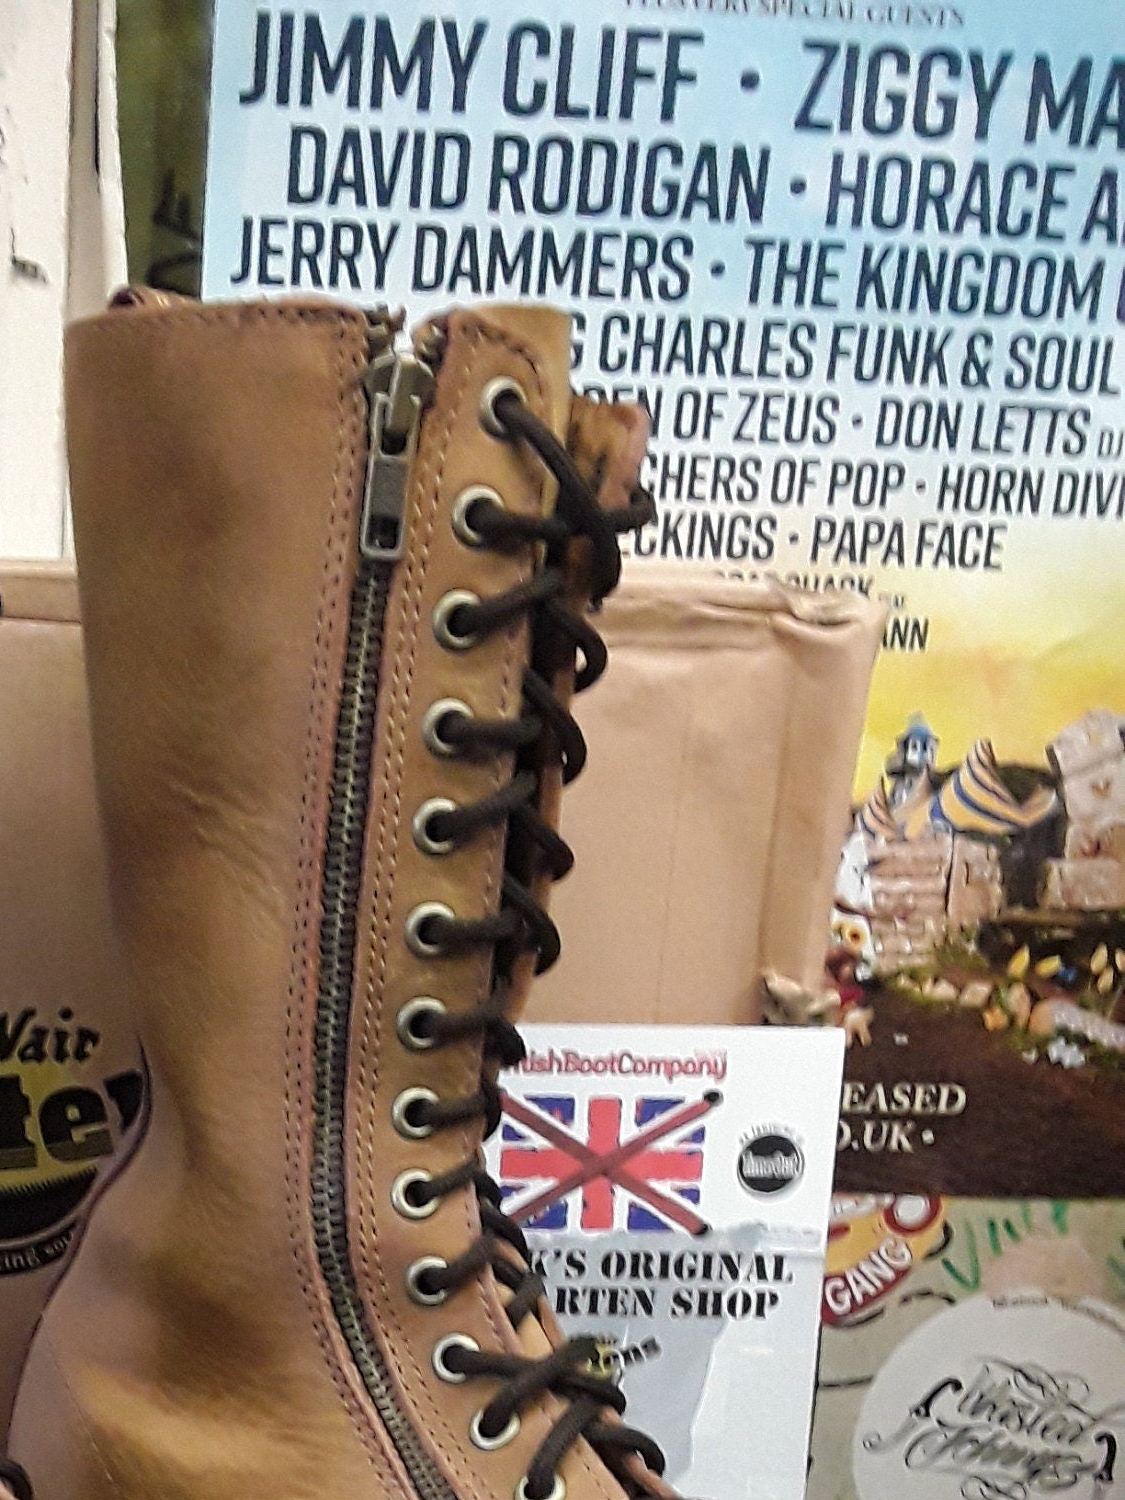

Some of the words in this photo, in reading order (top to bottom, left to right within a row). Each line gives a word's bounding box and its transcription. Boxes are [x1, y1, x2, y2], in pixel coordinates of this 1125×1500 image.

[239, 11, 488, 112] JIMMY
[502, 20, 704, 122] CLIFF
[793, 38, 1014, 144] ZIGGY
[286, 124, 471, 212] DAVID
[488, 132, 771, 225] RODIGAN
[825, 150, 1076, 240] HORACE
[1081, 166, 1125, 247] A
[230, 215, 401, 292] JERRY
[411, 224, 693, 302] DAMMERS
[744, 237, 846, 309] THE
[856, 243, 1106, 320] KINGDOM
[600, 312, 816, 382] CHARLES
[827, 323, 953, 387] FUNK
[961, 329, 992, 389] &
[1004, 334, 1121, 396] SOUL
[674, 387, 728, 441] OF
[733, 391, 840, 446] ZEUS
[876, 399, 965, 451] DON
[971, 402, 1091, 457] LETTS
[770, 458, 823, 505] OF
[828, 460, 906, 510] POP
[938, 465, 1048, 514] HORN
[622, 511, 777, 561] CKINGS
[811, 516, 905, 569] PAPA
[915, 521, 1009, 572] FACE
[842, 1082, 967, 1116] EASED
[556, 1286, 654, 1317] RTEN
[671, 1289, 780, 1319] SHOP
[601, 1251, 793, 1284] ORIGINAL
[825, 1237, 913, 1315] GANG
